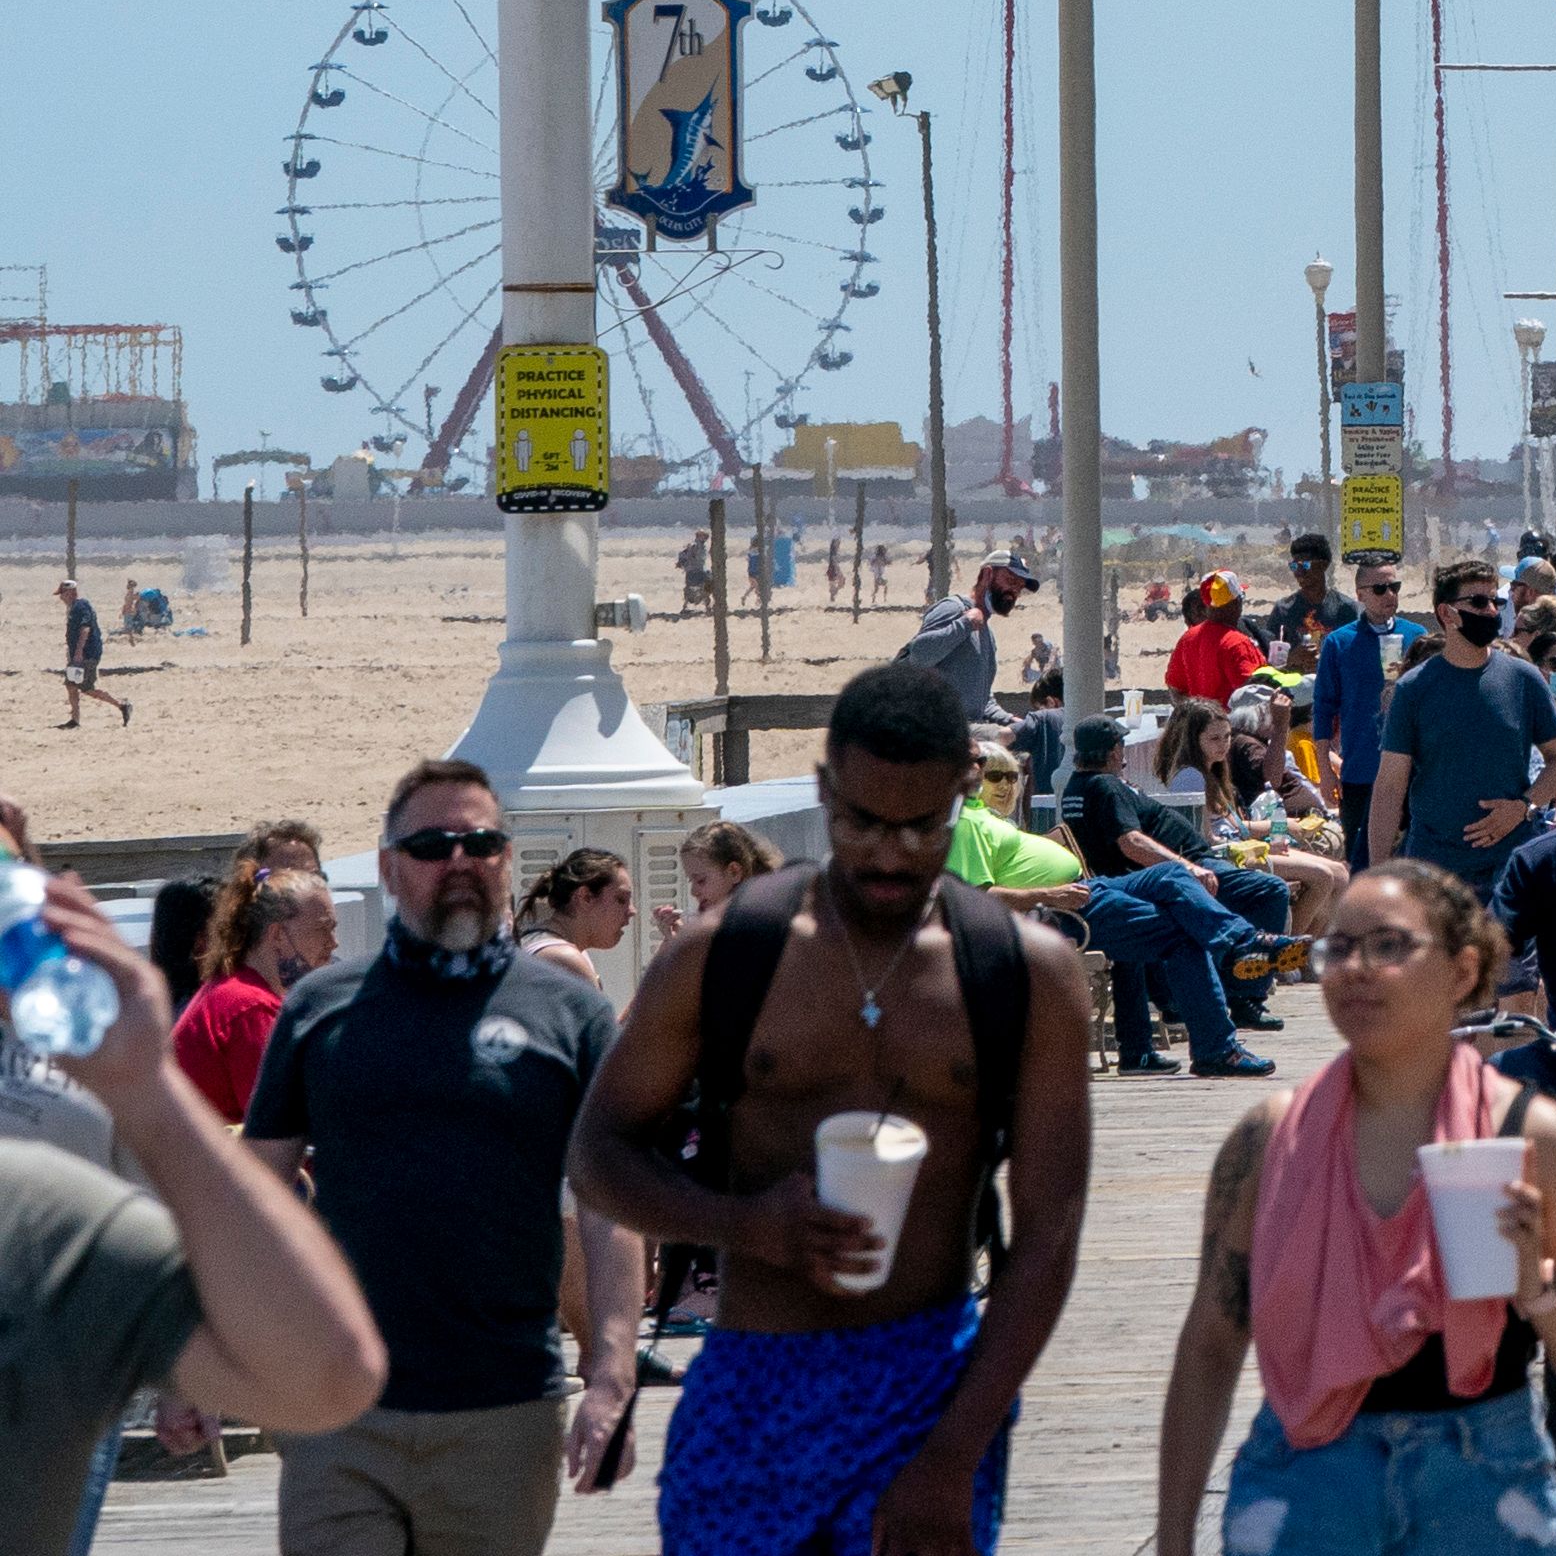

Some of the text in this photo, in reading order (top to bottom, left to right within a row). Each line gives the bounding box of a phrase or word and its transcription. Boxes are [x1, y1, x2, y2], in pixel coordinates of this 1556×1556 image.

[653, 4, 703, 82] 7th
[517, 370, 586, 382] PRACTICE
[517, 388, 586, 400] PHYSICAL
[510, 406, 597, 420] DISTANCING
